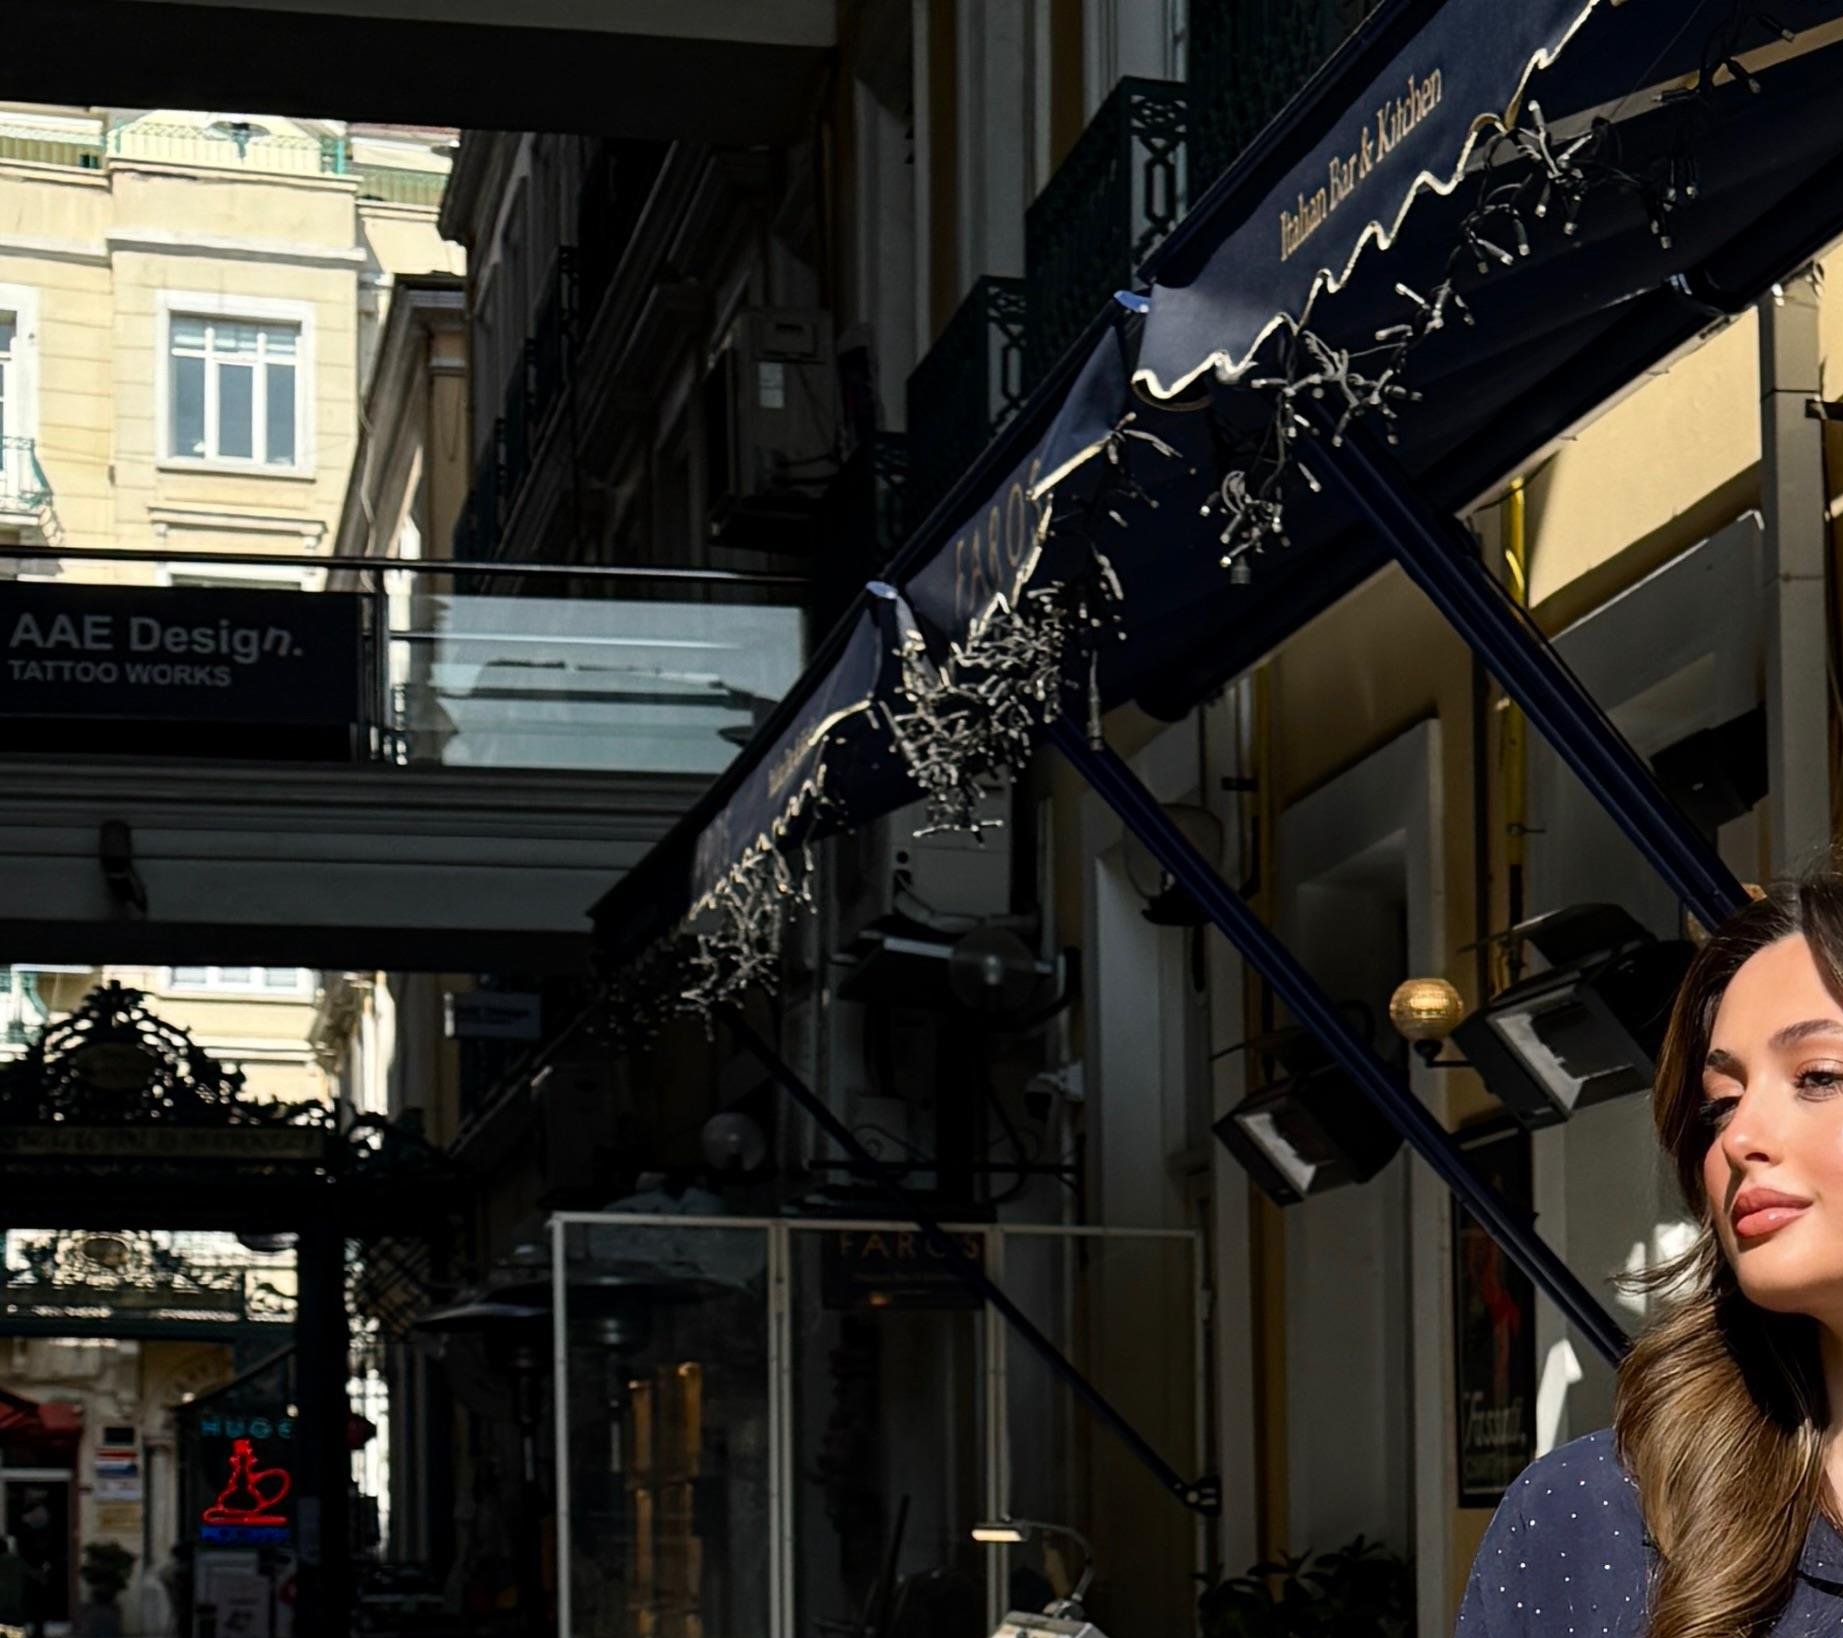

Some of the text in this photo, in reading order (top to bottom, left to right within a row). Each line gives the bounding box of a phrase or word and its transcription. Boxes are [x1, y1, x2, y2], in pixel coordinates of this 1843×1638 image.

[1280, 67, 1443, 262] Italian Bar & Kitchen
[8, 612, 304, 664] AAE Design.
[8, 659, 232, 688] TATTOO WORKS
